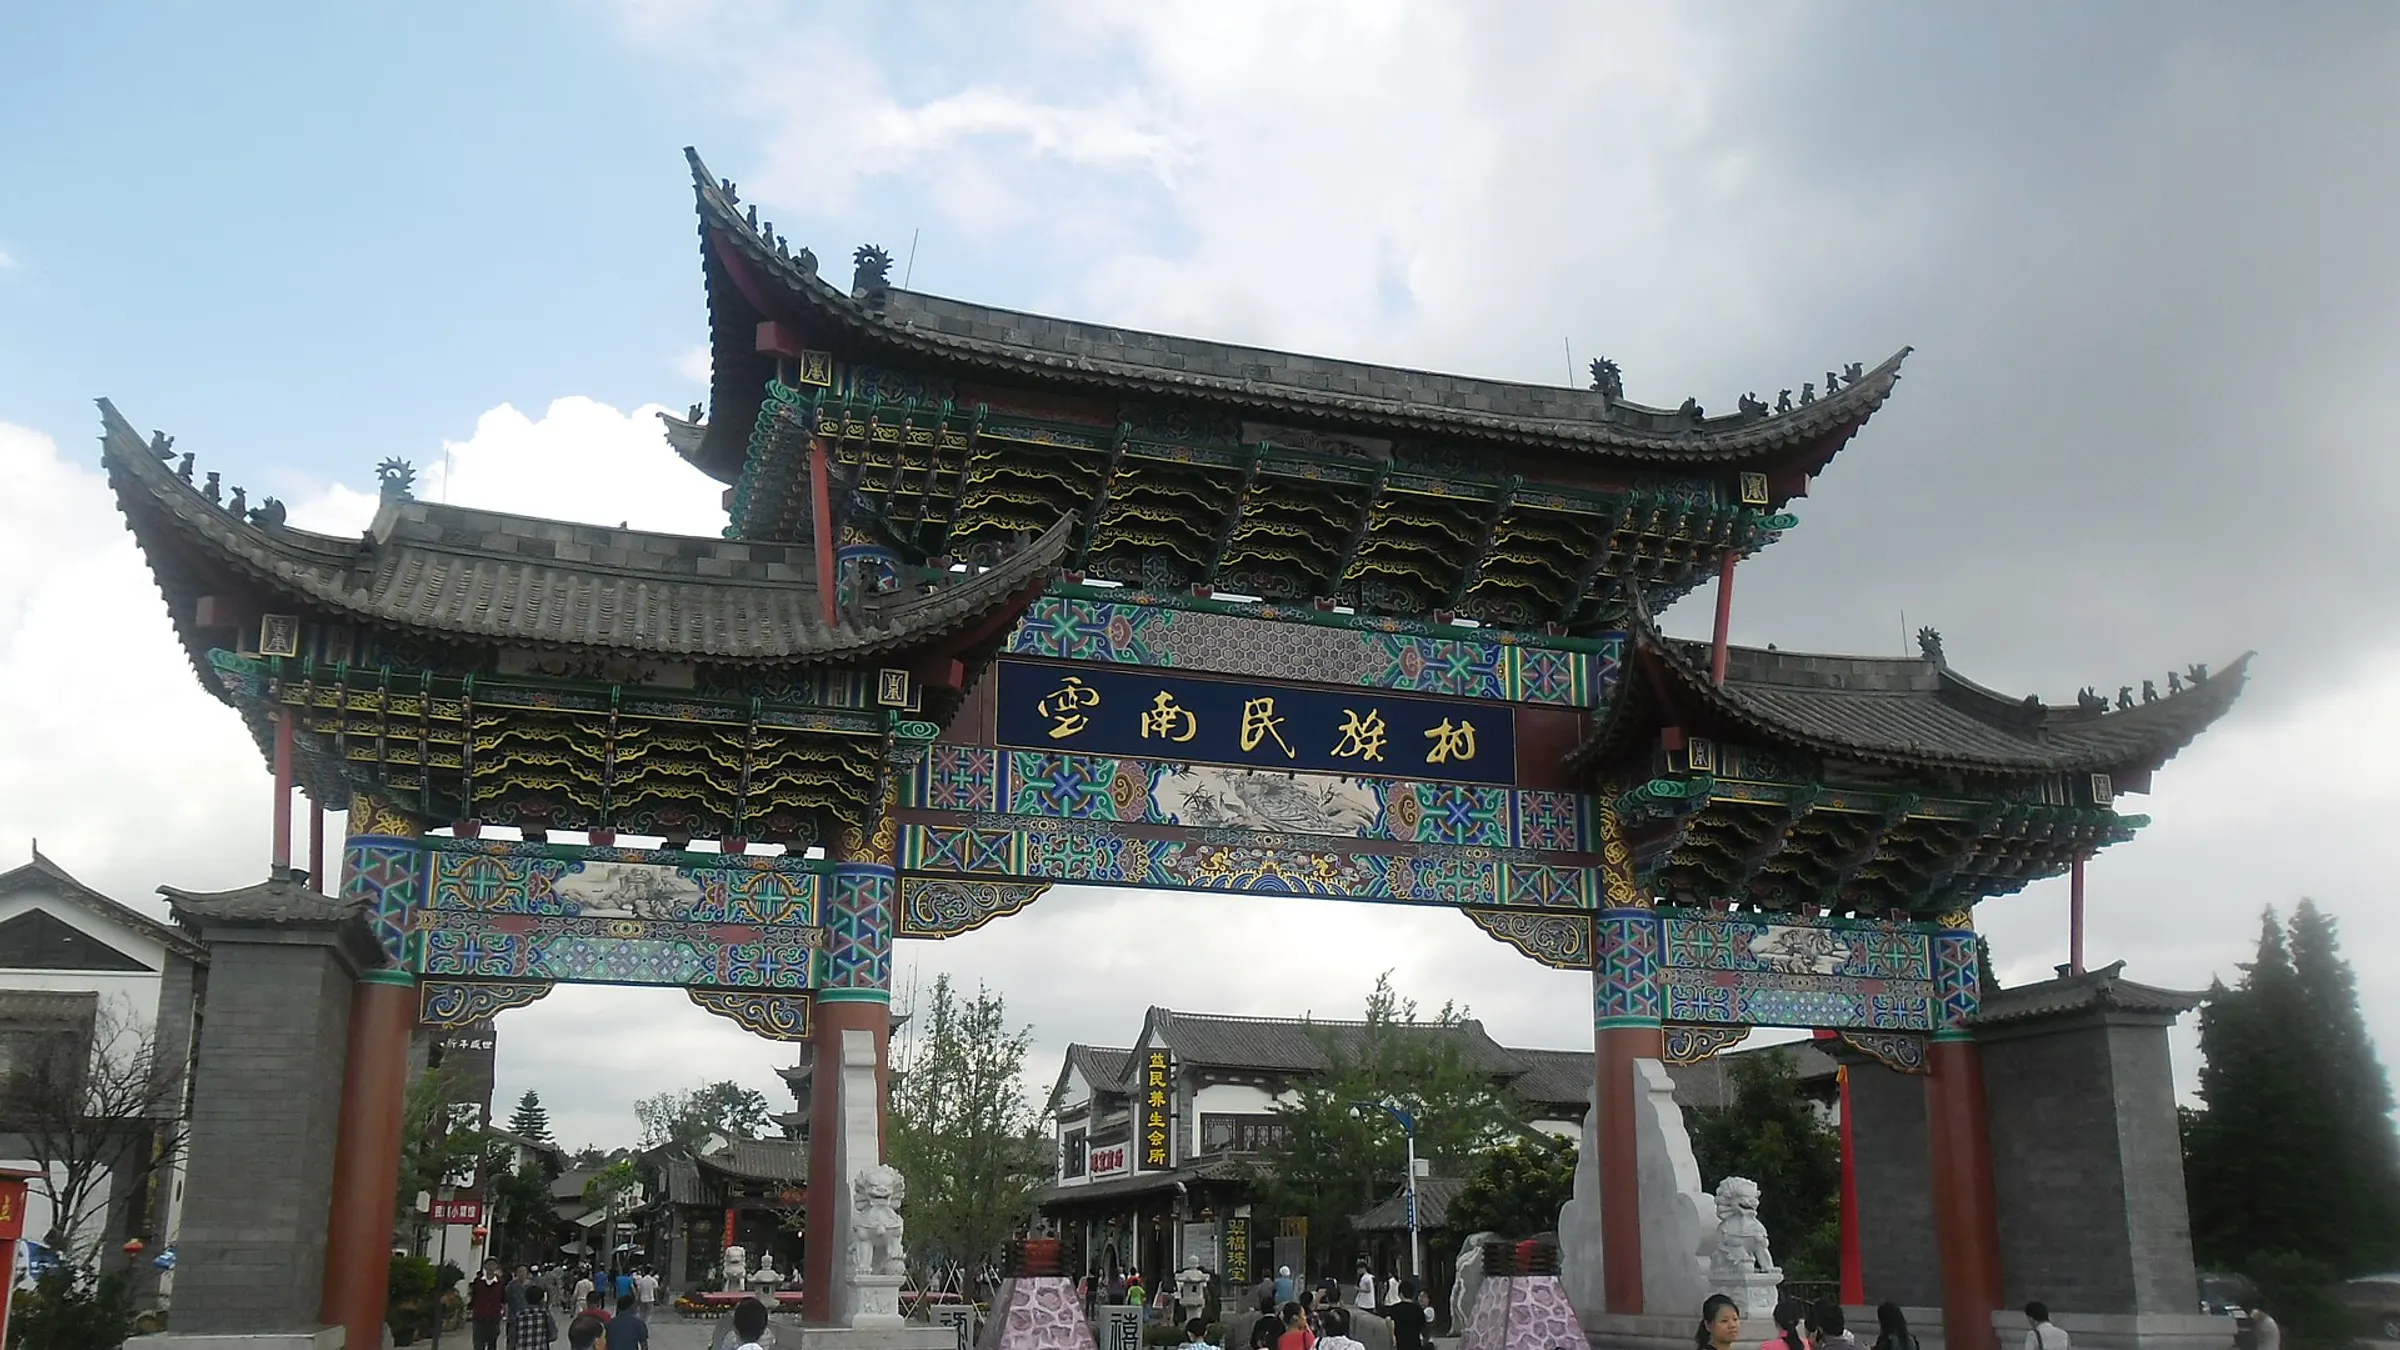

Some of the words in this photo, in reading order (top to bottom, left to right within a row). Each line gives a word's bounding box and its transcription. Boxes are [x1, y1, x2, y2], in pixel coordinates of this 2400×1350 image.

[1147, 1053, 1167, 1165] 益民养生会所
